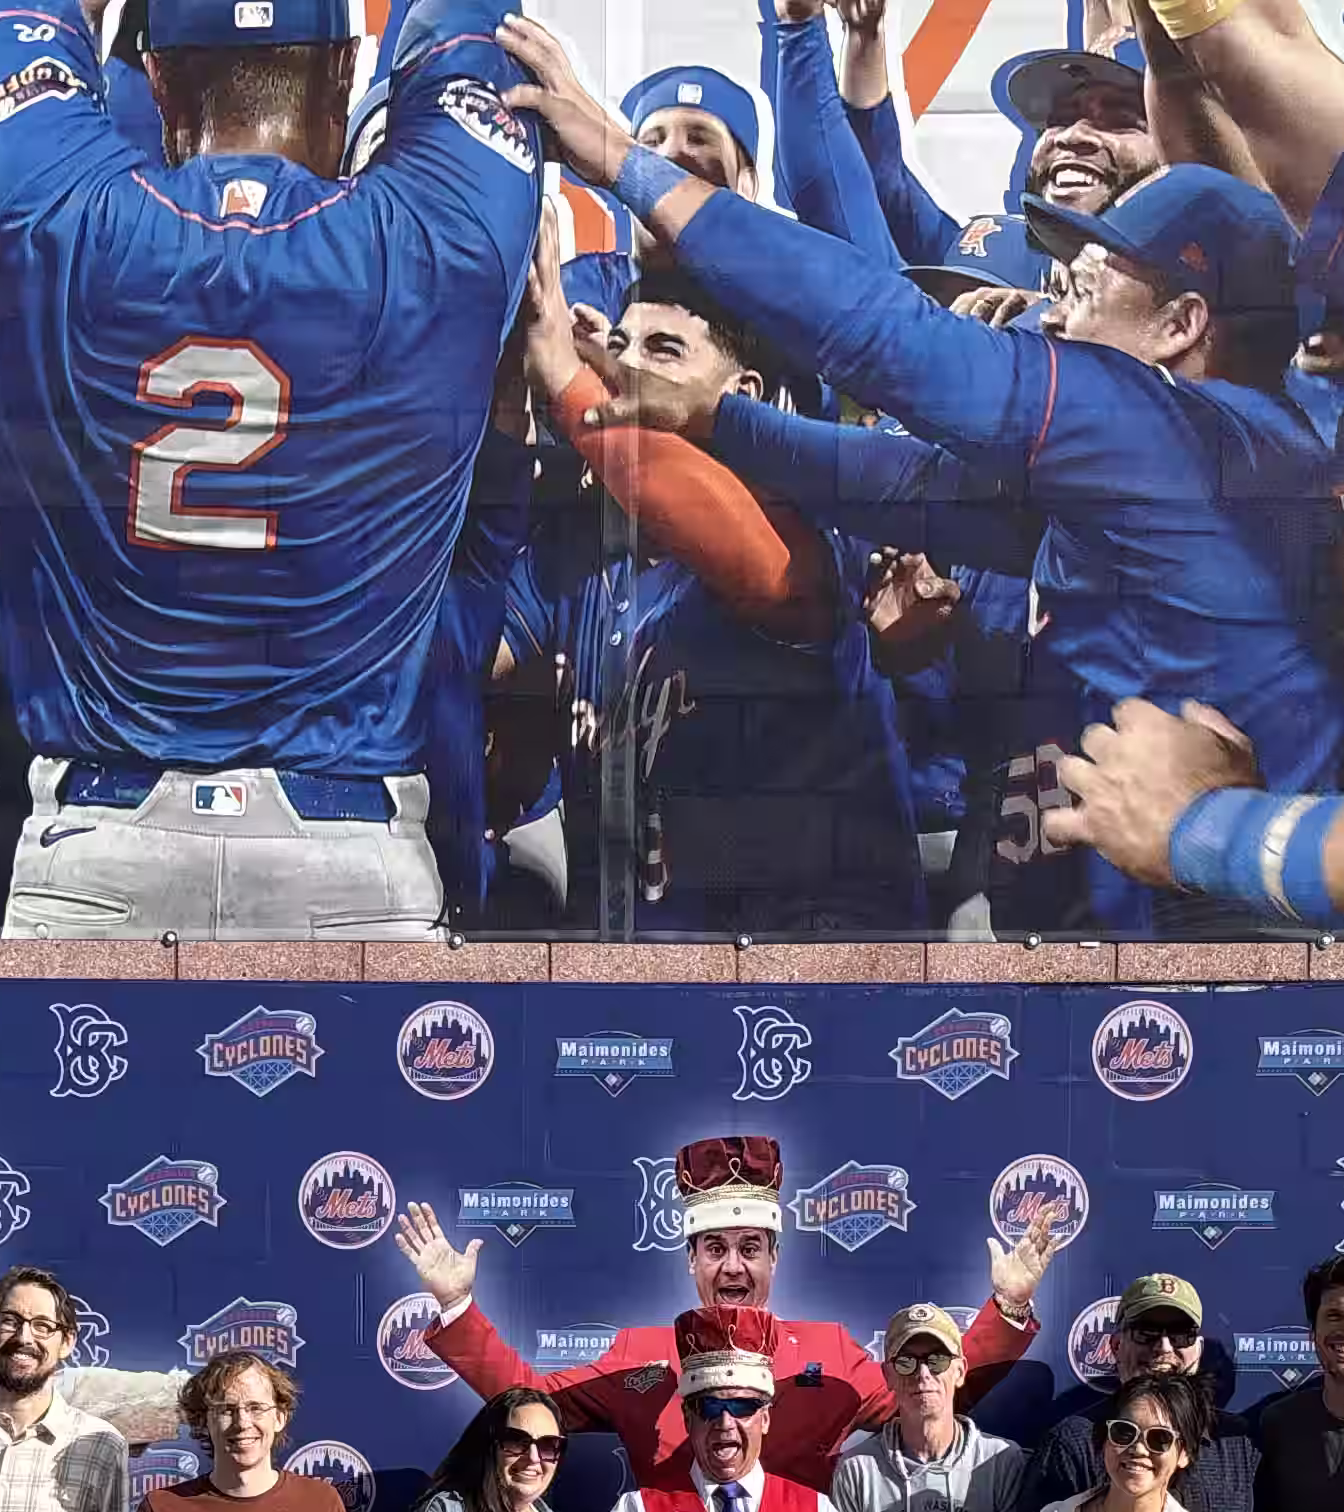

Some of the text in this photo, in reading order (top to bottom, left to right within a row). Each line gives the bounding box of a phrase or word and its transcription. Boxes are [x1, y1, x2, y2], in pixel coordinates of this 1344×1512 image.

[127, 335, 291, 551] 2
[213, 1035, 307, 1069] CYCLONES
[414, 1038, 476, 1069] Mets
[561, 1042, 668, 1057] Maimonides
[905, 1037, 1002, 1072] CYCLONES
[1109, 1038, 1174, 1069] Mets
[115, 1184, 209, 1218] CYCLONES
[317, 1188, 378, 1219] Mets
[463, 1192, 569, 1208] Maimonides
[804, 1190, 897, 1224] CYCLONES
[1159, 1194, 1269, 1209] Maimonides
[194, 1326, 288, 1360] CYCLONES
